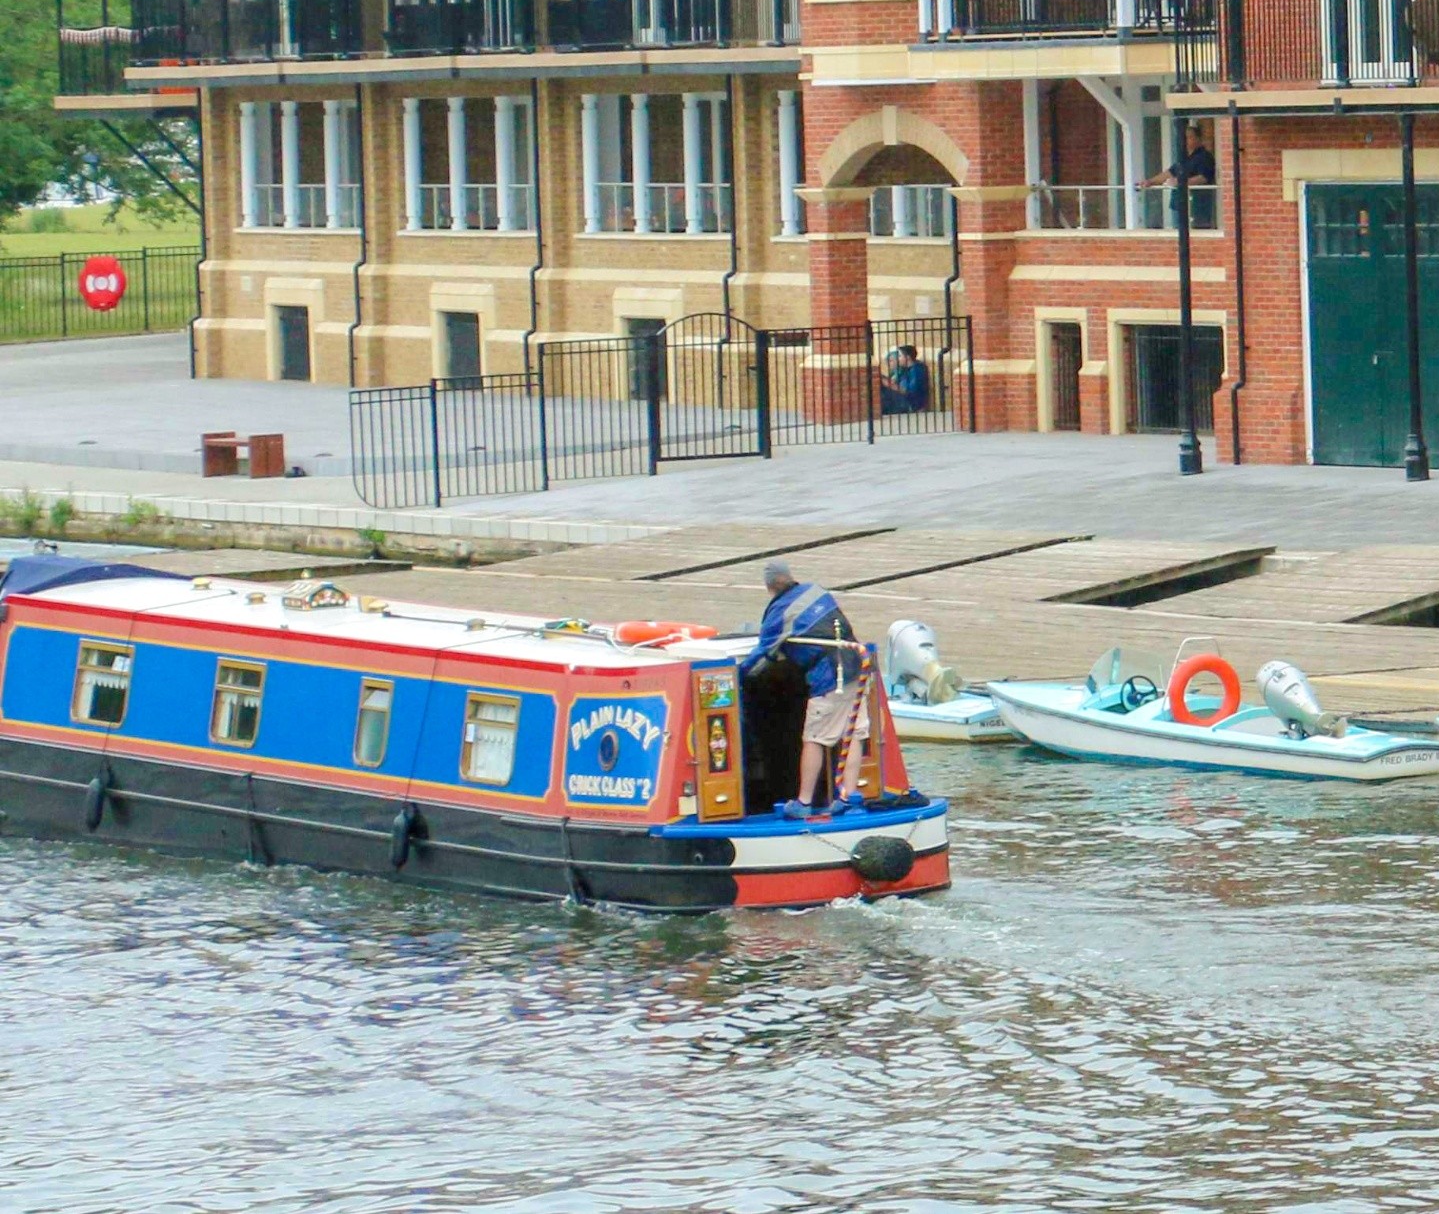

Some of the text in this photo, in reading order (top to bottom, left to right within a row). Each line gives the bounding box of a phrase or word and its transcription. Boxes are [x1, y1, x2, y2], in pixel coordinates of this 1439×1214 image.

[571, 705, 660, 751] PLAIN LAZY
[1380, 756, 1402, 765] FRED
[602, 776, 635, 798] CLASS
